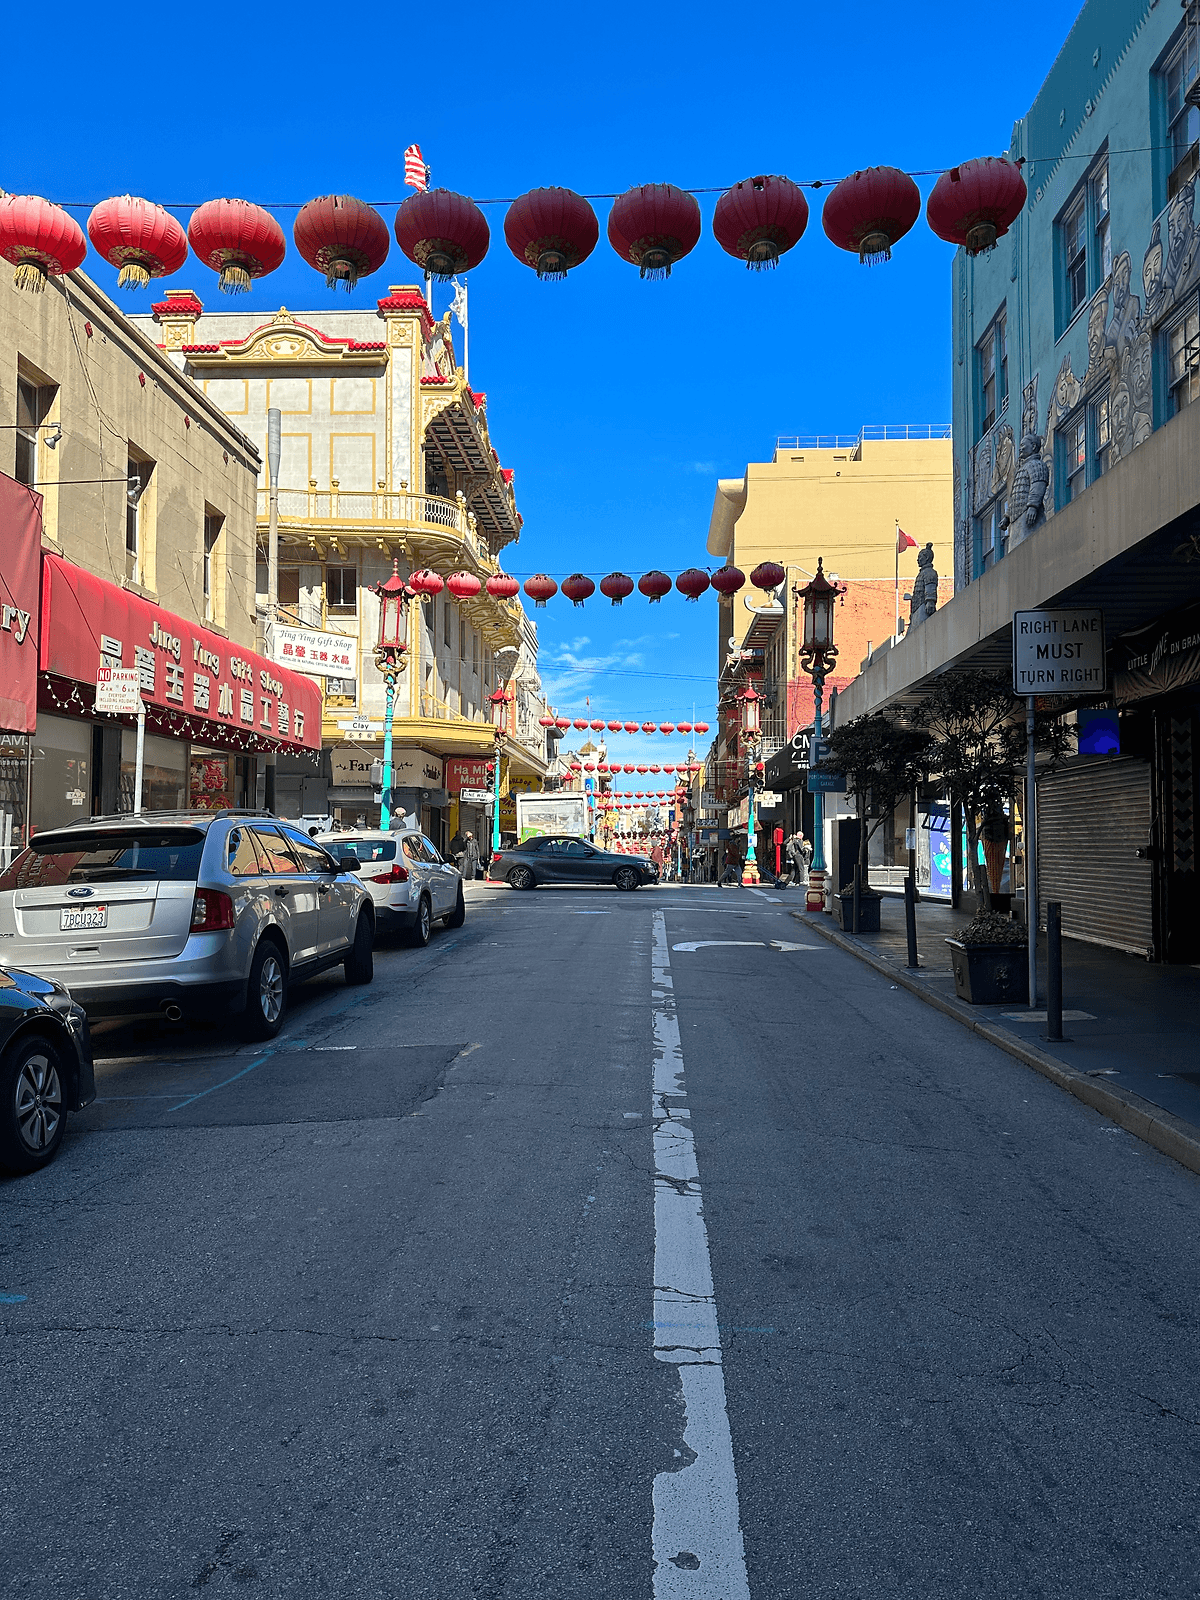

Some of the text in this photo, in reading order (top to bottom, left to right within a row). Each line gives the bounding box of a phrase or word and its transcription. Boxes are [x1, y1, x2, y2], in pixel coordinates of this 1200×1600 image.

[1020, 619, 1098, 634] RIGHT LANE
[279, 630, 352, 650] Jing Ying Gift Shop
[1036, 642, 1084, 660] MUST
[1128, 654, 1148, 670] LITTLE
[1148, 632, 1170, 676] JANE
[1170, 640, 1180, 654] ON
[149, 621, 284, 699] Jing Ying Gift Shop
[99, 669, 138, 681] NO PARKING
[1020, 668, 1100, 684] TURN RIGHT
[814, 742, 831, 763] P
[454, 764, 469, 774] Ha
[460, 775, 486, 784] Mart
[64, 912, 103, 926] 7BCU323
